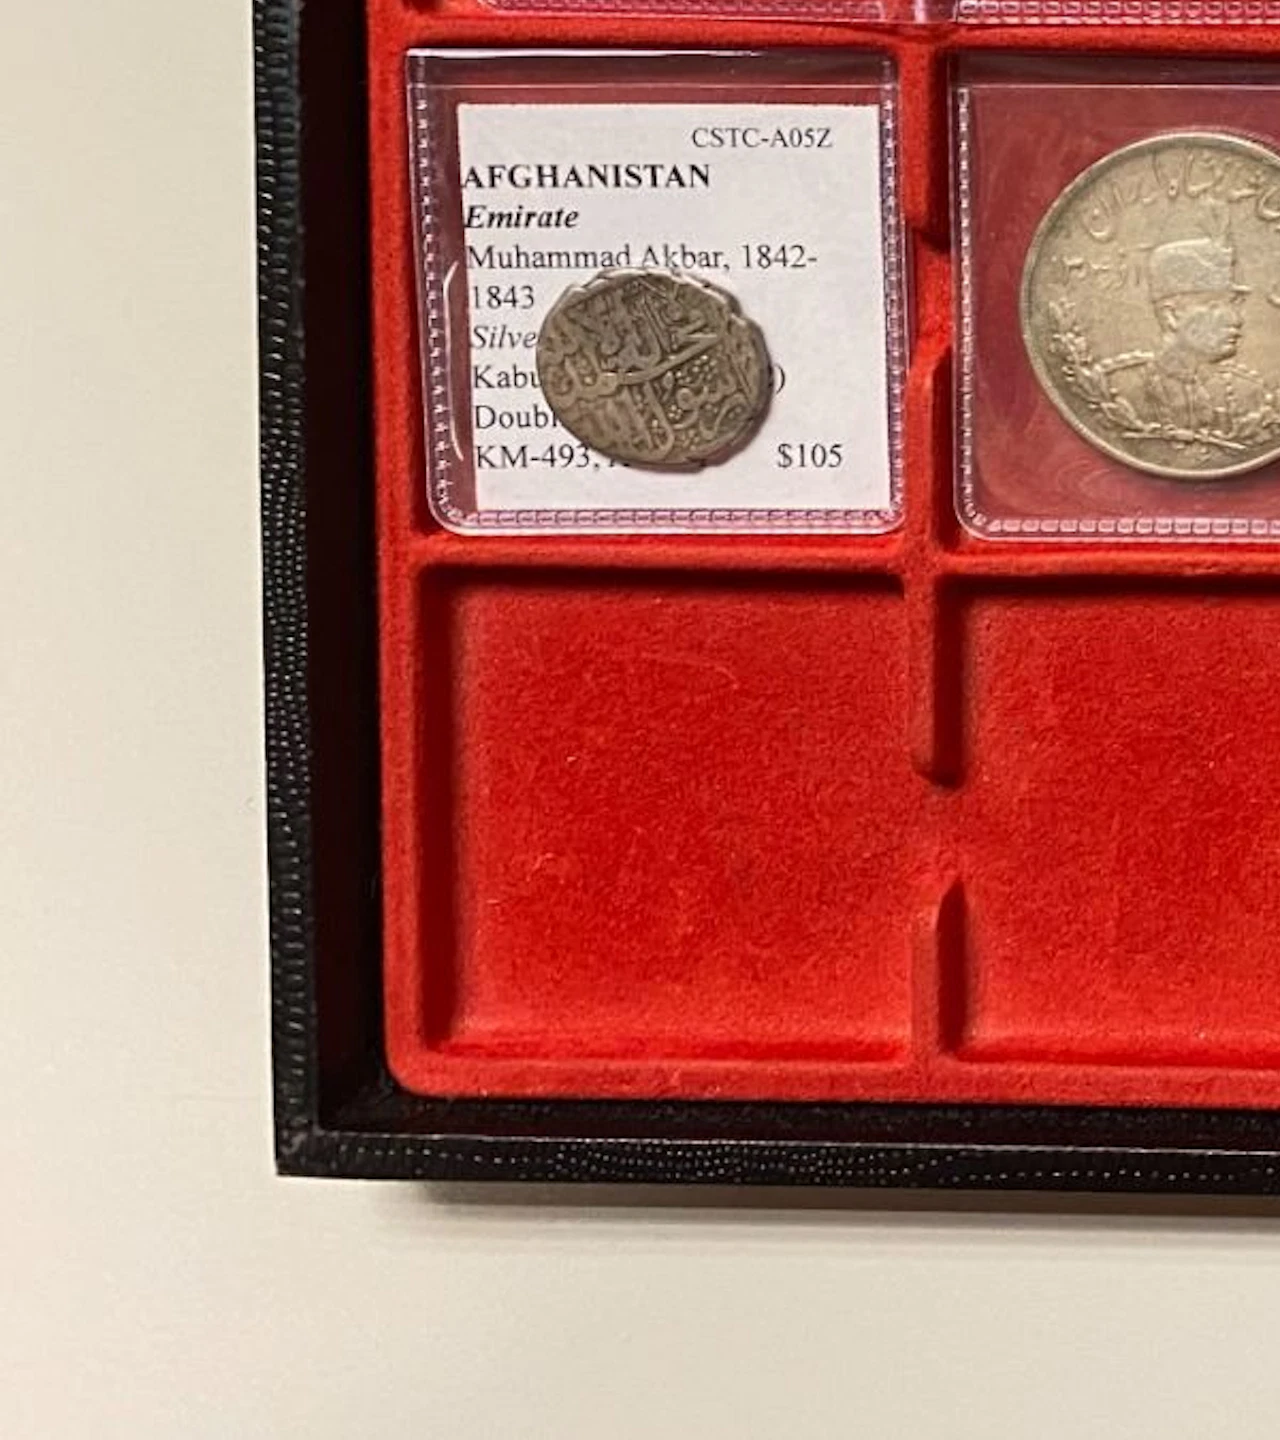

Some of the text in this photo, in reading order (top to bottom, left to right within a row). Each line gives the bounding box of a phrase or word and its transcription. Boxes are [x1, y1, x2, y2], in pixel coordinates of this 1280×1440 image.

[691, 127, 834, 150] CSTC-A05Z
[462, 163, 712, 189] AFGHANISTAN
[464, 207, 580, 230] Emirate
[467, 244, 819, 272] Muhammad Akbar, 1842-
[472, 285, 536, 310] 1843
[472, 326, 537, 350] Silve
[473, 364, 542, 390] Kabu
[474, 404, 558, 429] Doub
[777, 442, 844, 471] $105
